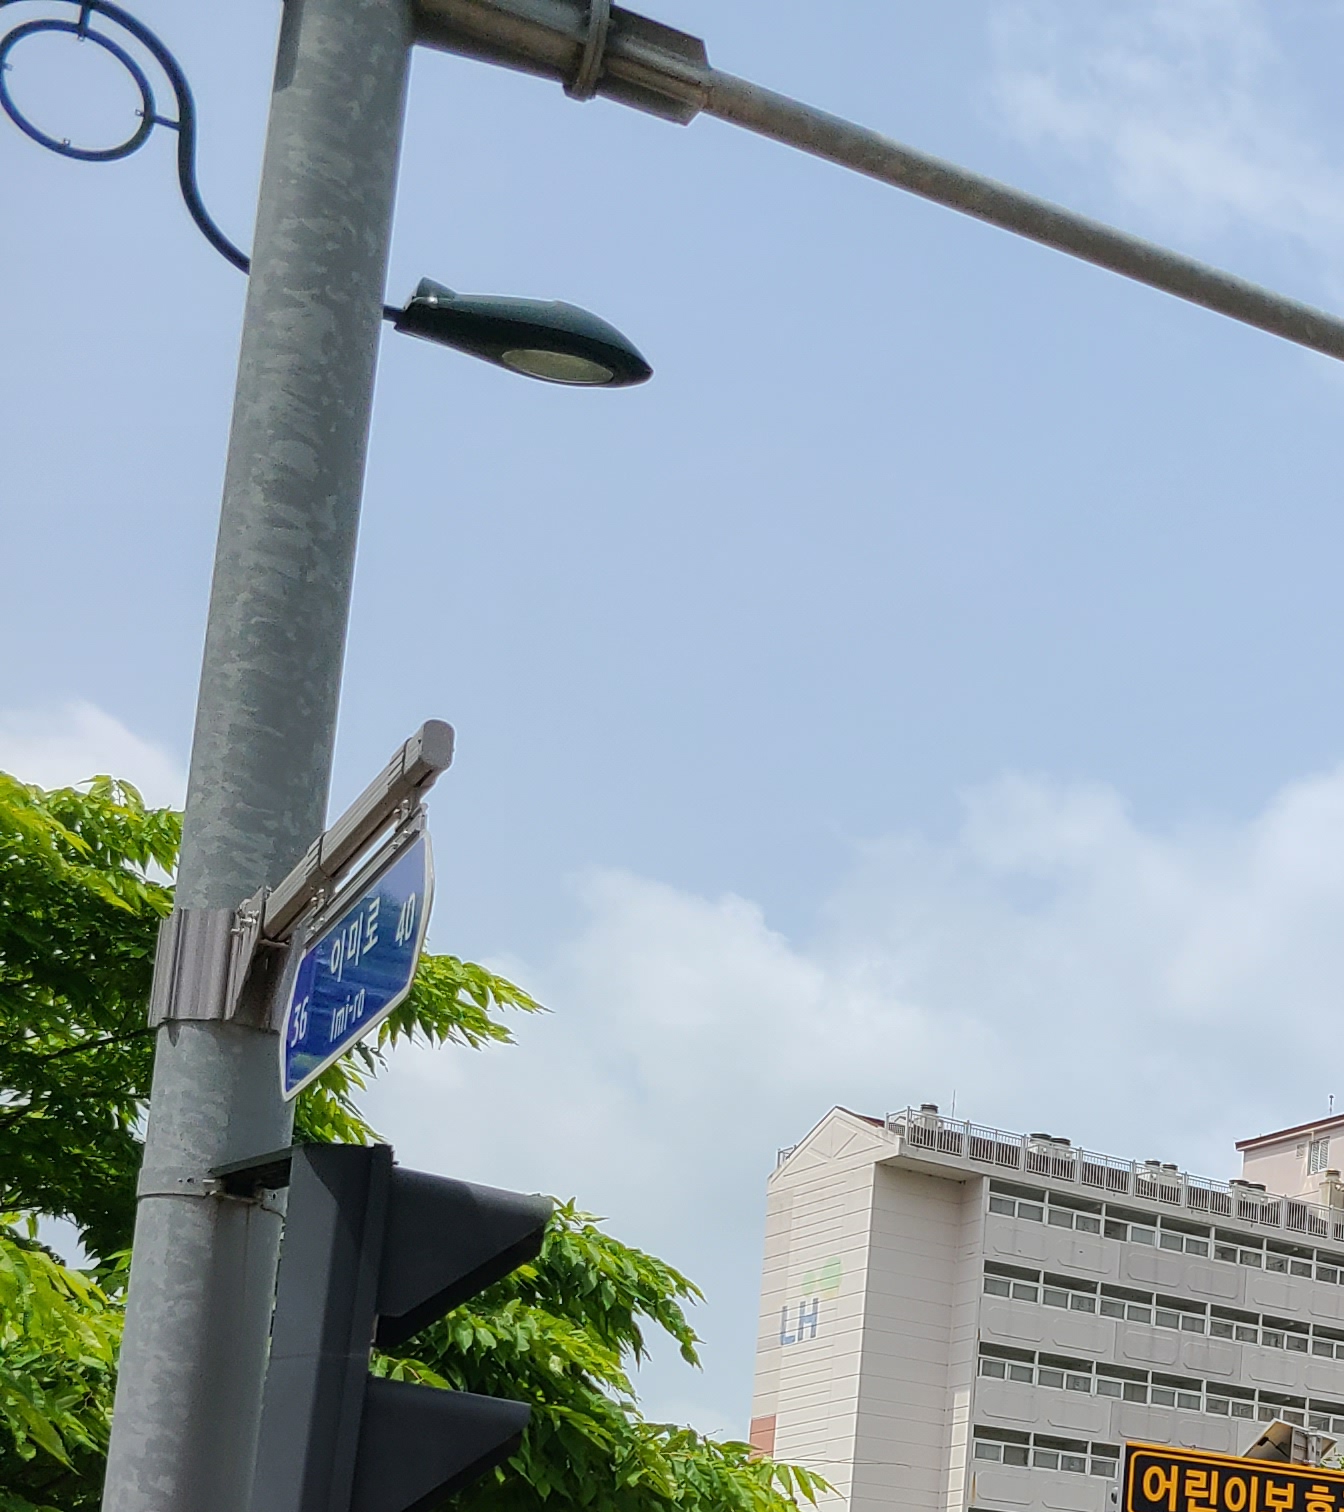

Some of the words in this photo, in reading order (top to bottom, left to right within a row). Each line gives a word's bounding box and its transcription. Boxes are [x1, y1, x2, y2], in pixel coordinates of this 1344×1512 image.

[330, 896, 381, 983] 이미로
[394, 892, 417, 947] 40
[289, 995, 309, 1048] 36
[329, 987, 366, 1043] Imi-ro
[780, 1297, 819, 1346] LH
